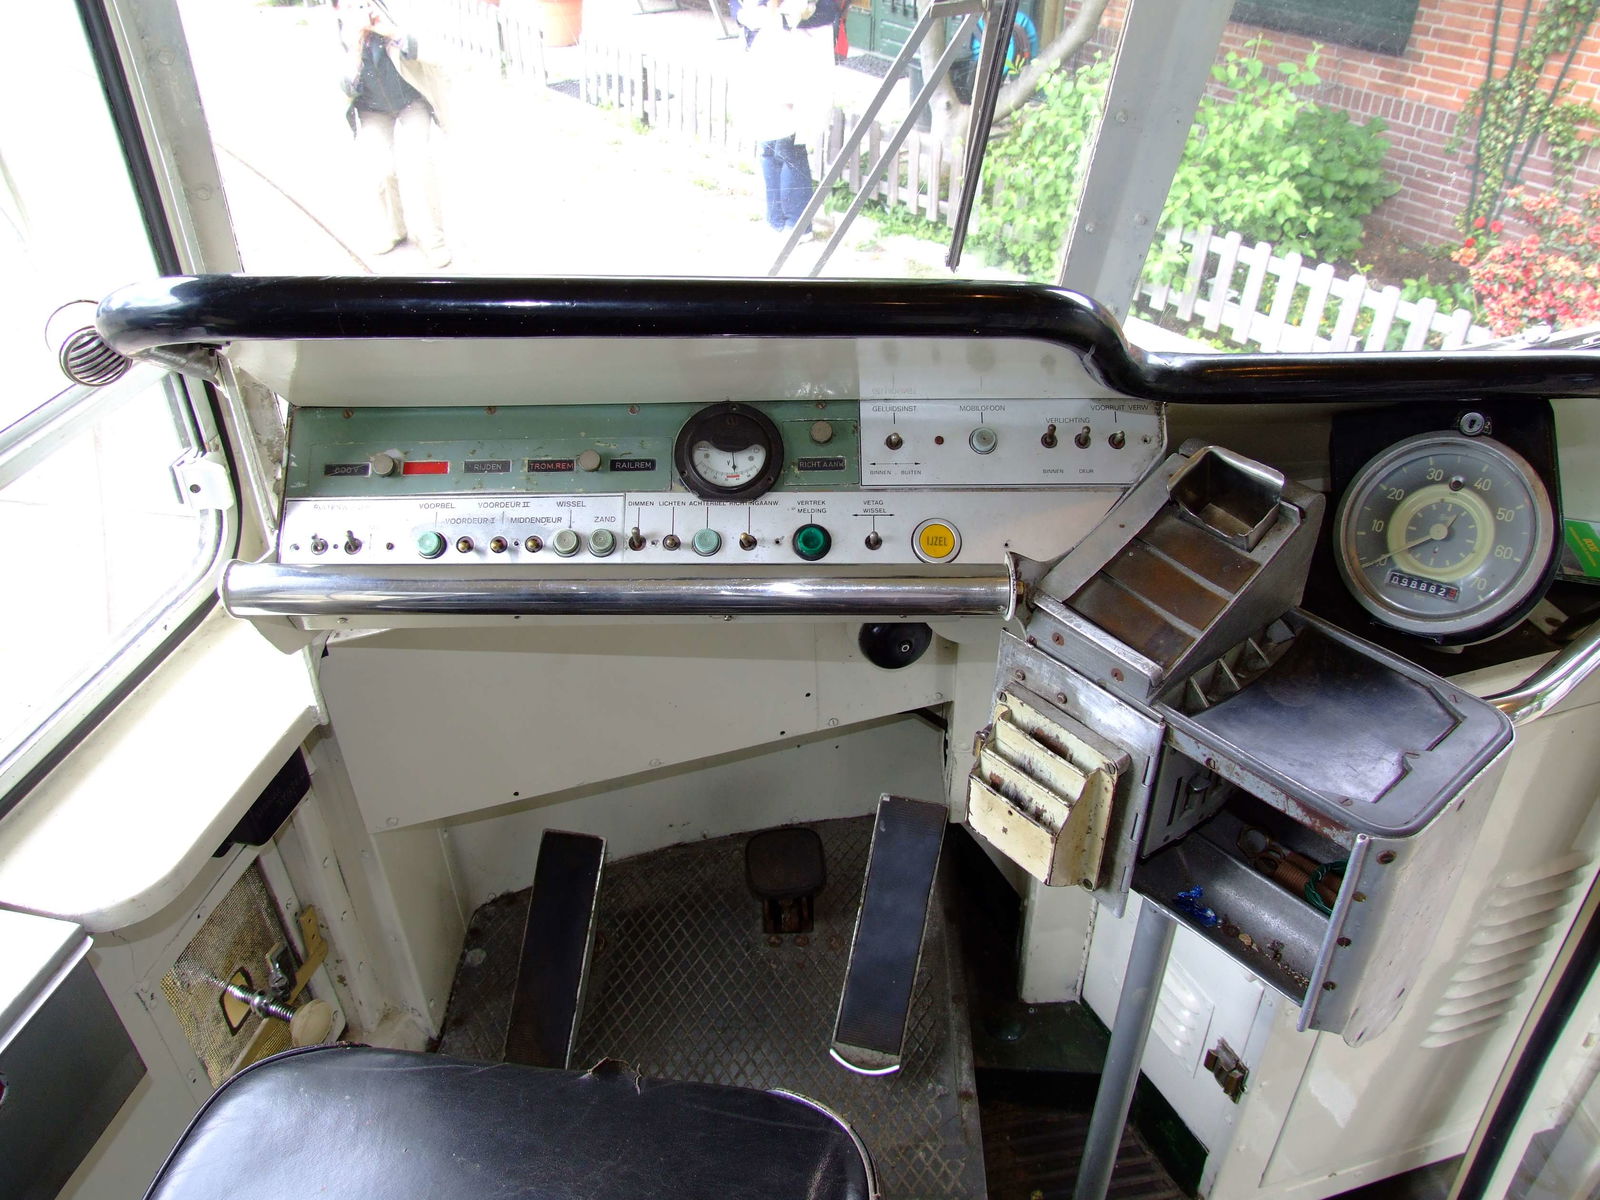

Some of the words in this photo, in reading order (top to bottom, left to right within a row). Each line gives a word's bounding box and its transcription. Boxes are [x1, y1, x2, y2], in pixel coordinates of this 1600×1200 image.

[871, 404, 918, 413] GELUIDSINST
[958, 404, 1007, 412] MOBILOFOON
[1045, 416, 1091, 425] VERLICHTING
[473, 462, 503, 472] RIJDEN
[1426, 468, 1444, 481] 30
[1474, 478, 1492, 491] 40
[1387, 487, 1405, 500] 20
[418, 502, 456, 510] VOORBEL
[477, 500, 521, 509] VOORDEUR
[556, 500, 586, 508] WISSEL
[593, 515, 617, 523] ZAND
[1496, 508, 1515, 522] 50
[444, 517, 489, 525] VOORDEUR
[509, 516, 563, 524] MIDDENDEUR
[1371, 519, 1384, 533] 10
[926, 536, 948, 546] IJZEL
[1494, 545, 1513, 559] 60
[1470, 577, 1487, 590] 70
